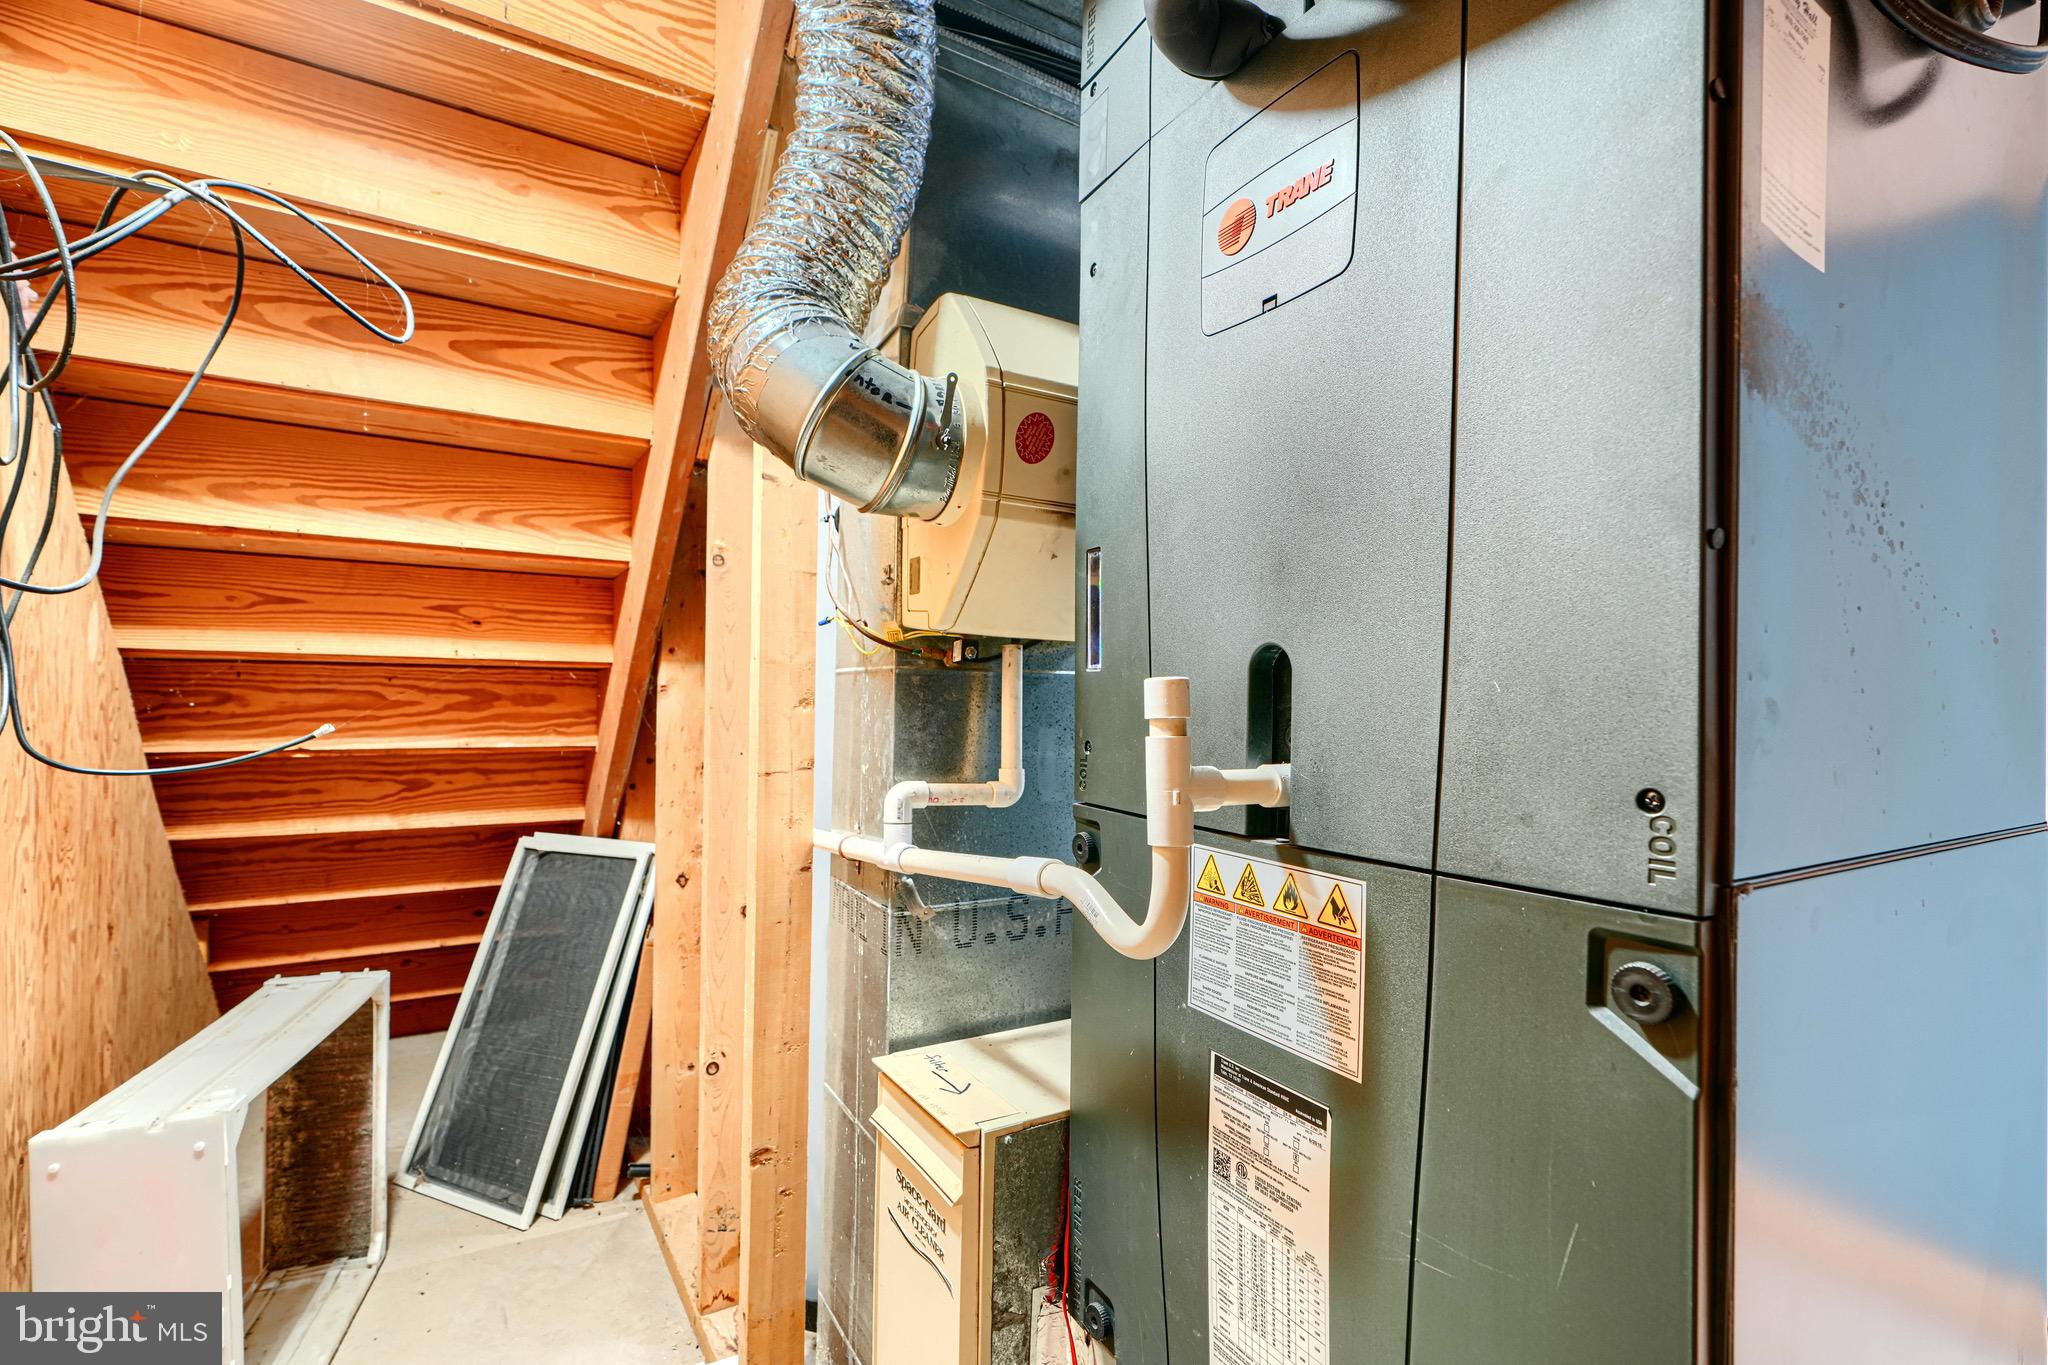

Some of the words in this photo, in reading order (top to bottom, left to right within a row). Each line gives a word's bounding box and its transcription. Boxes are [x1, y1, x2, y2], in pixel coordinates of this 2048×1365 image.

[1086, 4, 1096, 70] HEATER
[1266, 158, 1335, 219] TRANE
[1079, 754, 1088, 791] COIL
[1648, 815, 1677, 886] COIL
[1204, 896, 1229, 910] WARNING
[1244, 908, 1295, 929] AVERTISSEMENT
[1309, 928, 1360, 949] ADVERTENCIA
[895, 1168, 946, 1235] Space-Gard
[1073, 1176, 1083, 1235] FILTER
[911, 1216, 945, 1264] CLEANER
